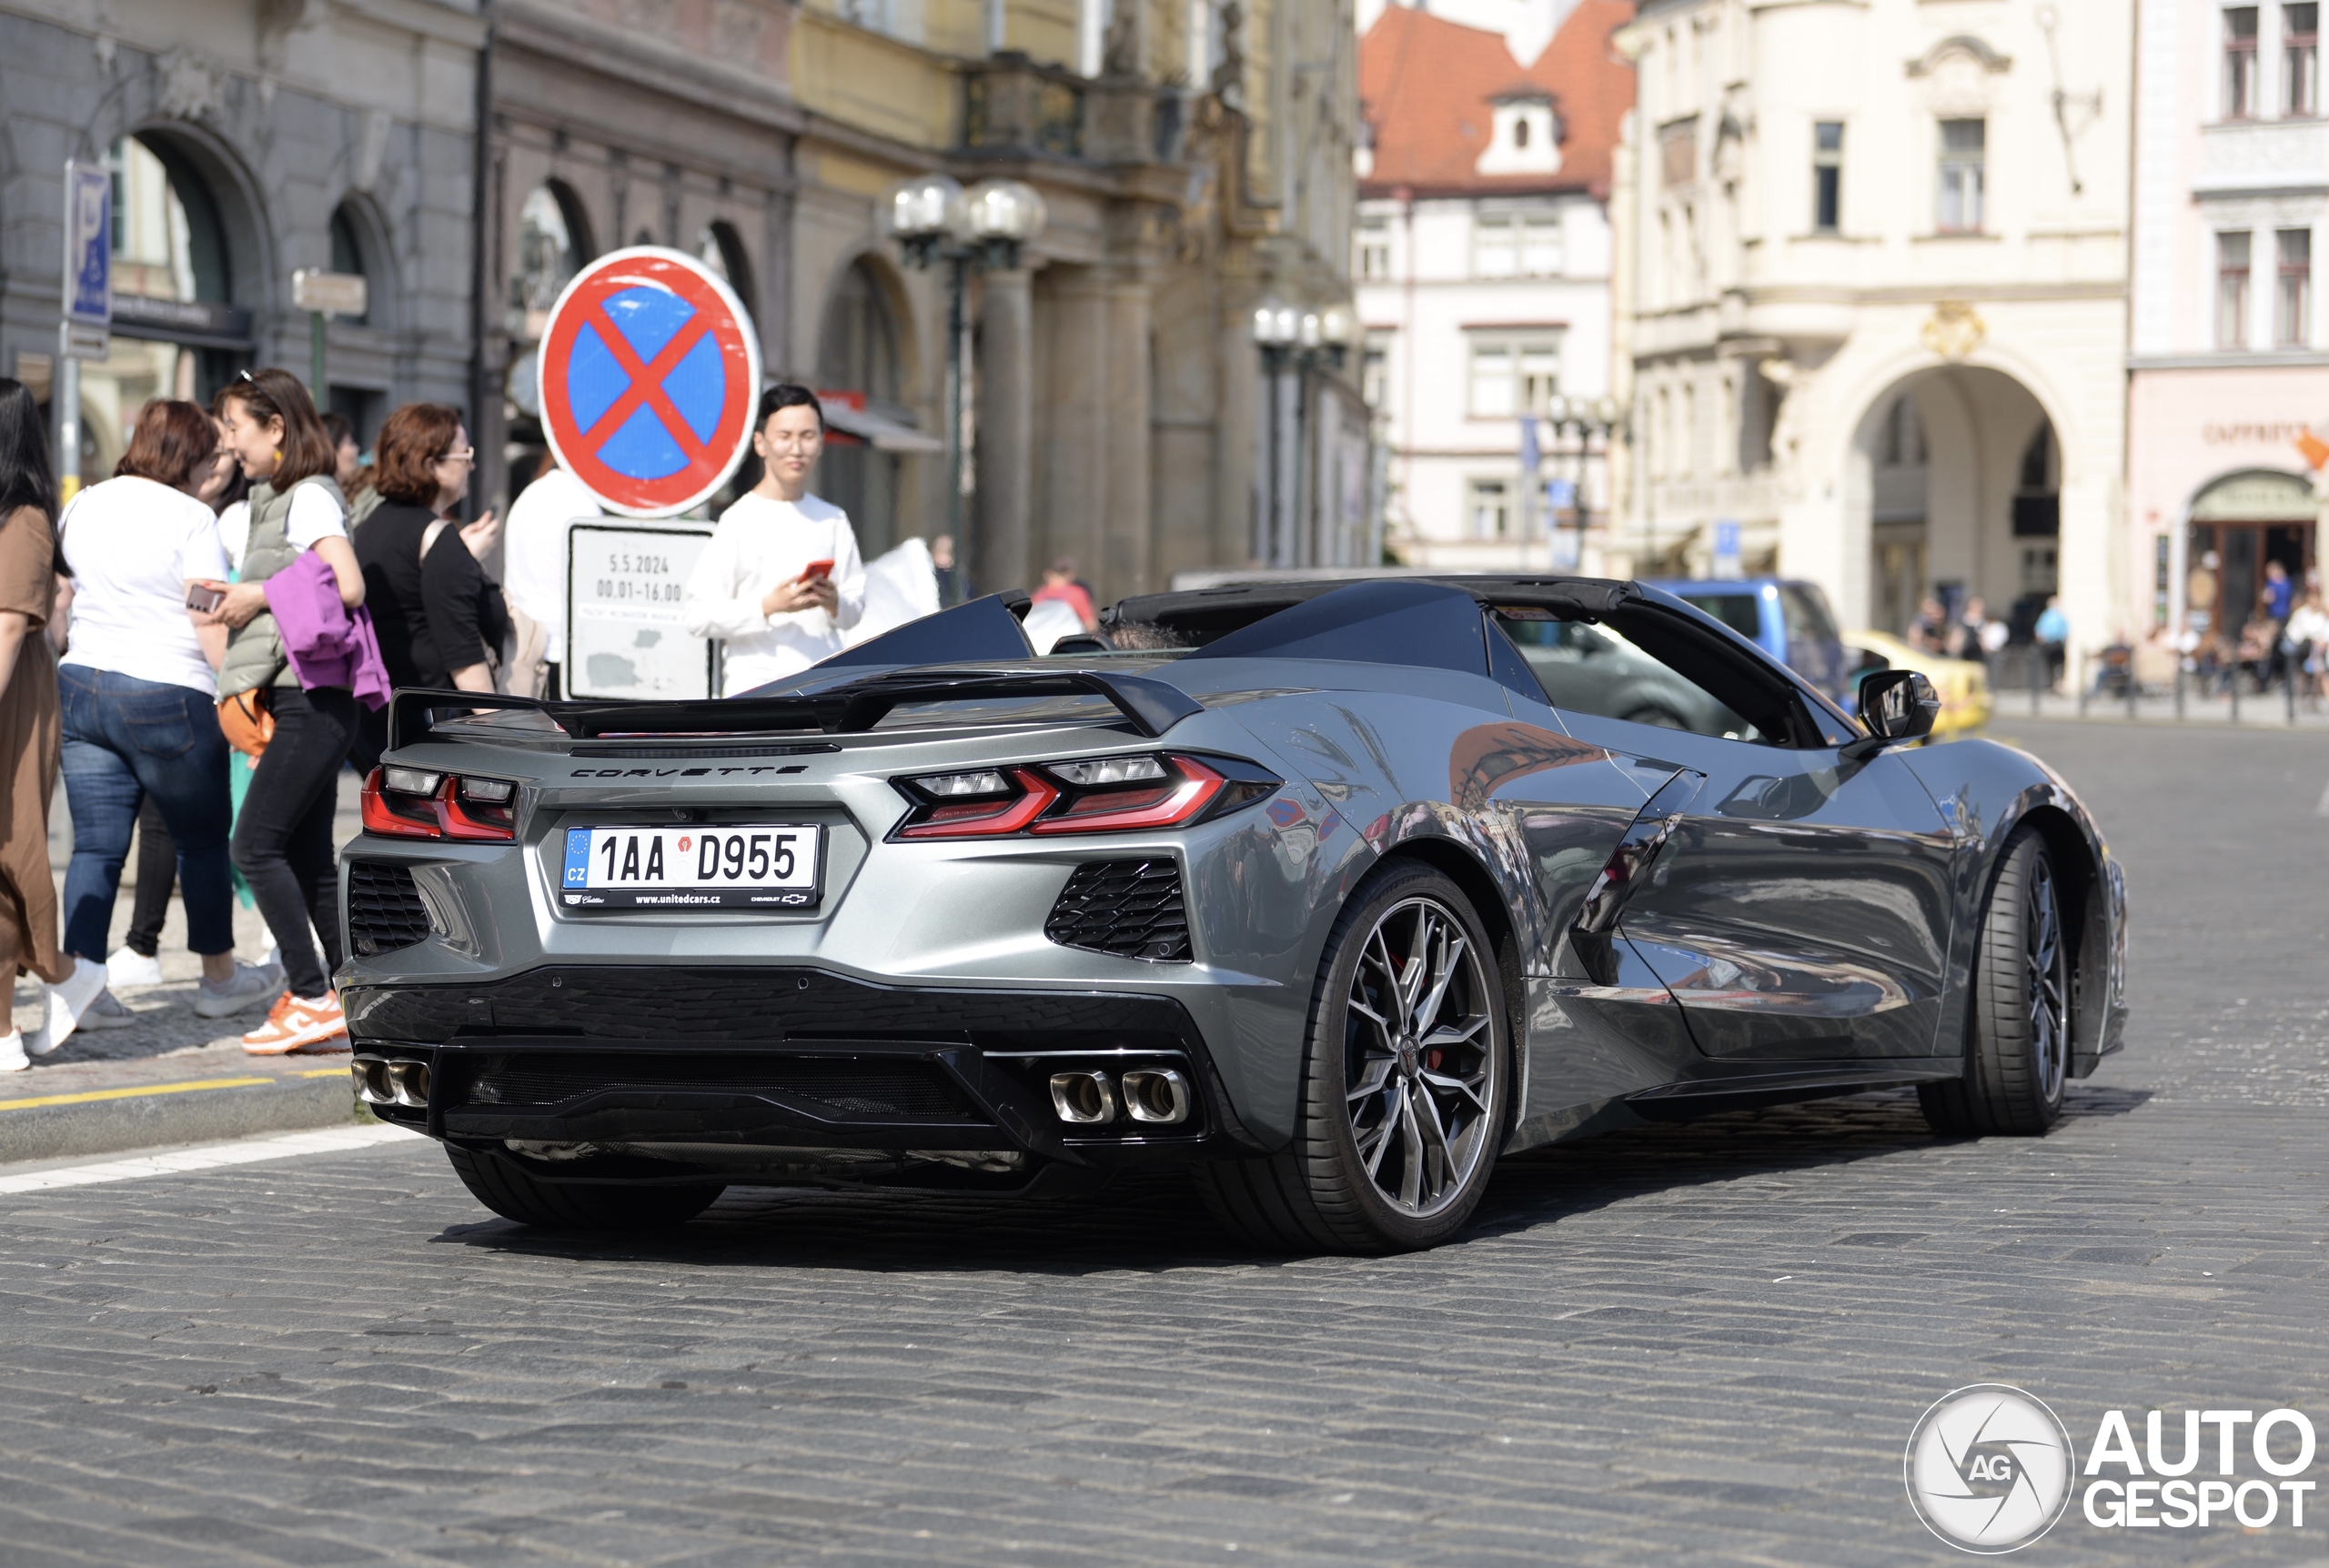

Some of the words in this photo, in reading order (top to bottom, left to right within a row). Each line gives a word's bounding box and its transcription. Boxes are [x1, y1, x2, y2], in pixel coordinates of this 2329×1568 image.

[610, 555, 669, 575] 5.5.2024
[570, 766, 809, 778] CORVETTE
[601, 835, 664, 880] 1AA
[698, 834, 798, 880] D955
[568, 868, 585, 881] CZ
[582, 895, 605, 904] Cadillac
[636, 894, 721, 904] www.unitedcars.cz
[1422, 1209, 1466, 1238] MICHELIN
